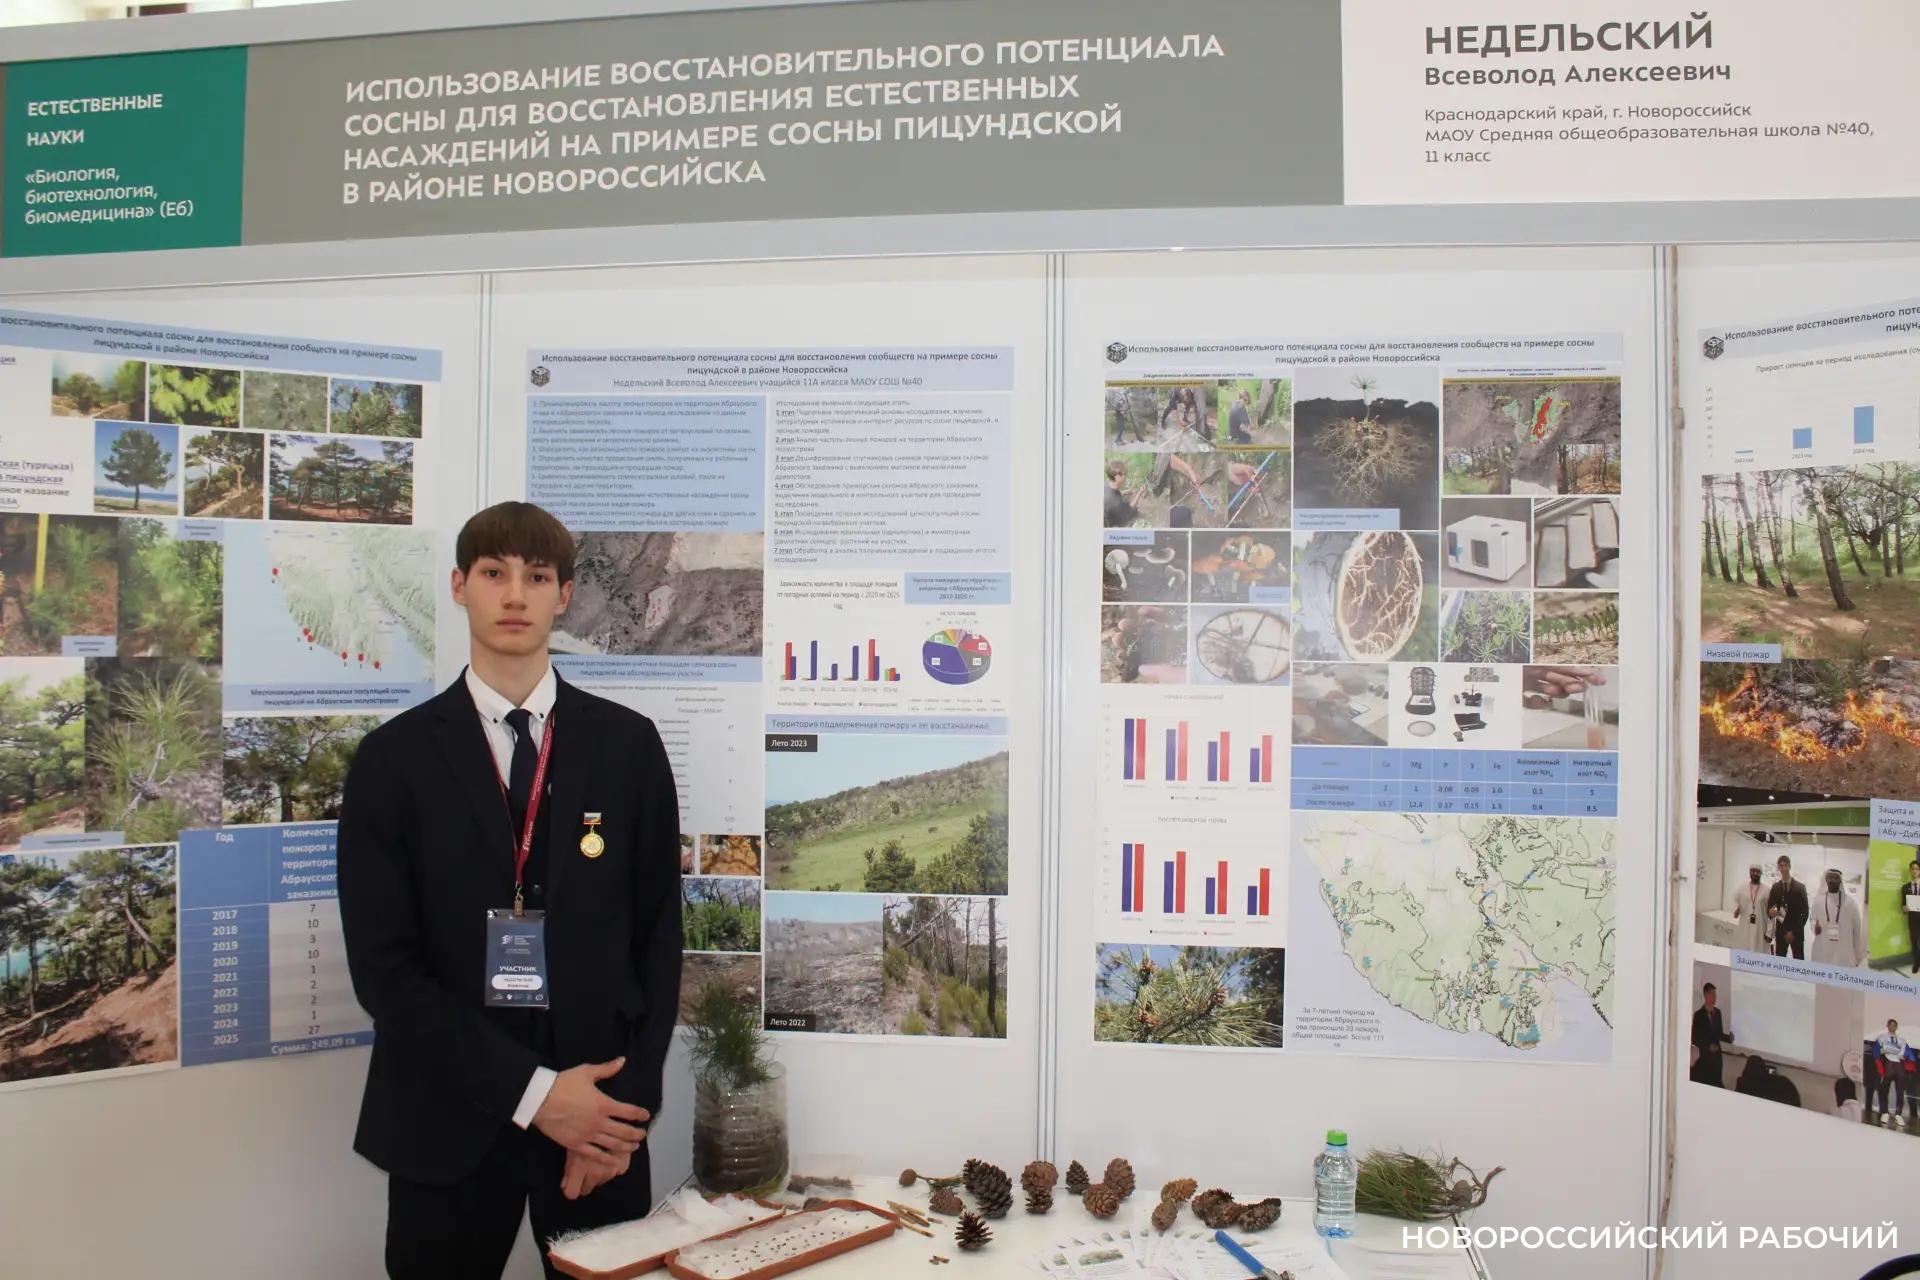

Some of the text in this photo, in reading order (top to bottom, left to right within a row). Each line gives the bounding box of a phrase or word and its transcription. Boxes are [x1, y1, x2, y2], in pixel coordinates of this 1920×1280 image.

[1425, 11, 1713, 58] НЕДЕЛЬСКИЙ
[346, 34, 1224, 103] ИСПОЛЬЗОВАНИЕ ВОССТАНОВИТЕЛЬНОГО ПОТЕНЦИАЛА
[1425, 62, 1731, 87] Всеволод Алексеевич
[27, 93, 163, 117] ЕСТЕСТВЕННЫЕ
[345, 74, 1079, 137] СОСНЫ ДЛЯ ВОССТАНОВЛЕНИЯ ЕСТЕСТВЕННЫХ
[1425, 102, 1752, 122] Краснодарский край, г. Новороссийск
[27, 129, 84, 147] НАУКИ
[344, 103, 1122, 170] НАСАЖДЕНИЙ НА ПРИМЕРЕ СОСНЫ ПИЦУНДСКОЙ
[1425, 122, 1874, 143] МАОУ Средняя общеобразовательная школа №40,
[1425, 150, 1492, 163] 11 класс
[25, 167, 120, 184] «Биология,
[344, 156, 766, 205] В РАЙОНЕ НОВОРОССИЙСКА
[25, 185, 158, 204] биотехнология,
[25, 205, 154, 225] биомедицина»
[1725, 305, 1920, 342] Использование восстановительного поте
[1886, 321, 1920, 333] пицун
[93, 338, 152, 351] пицундской
[163, 344, 198, 355] районе
[200, 347, 269, 361] Новороссийска
[106, 326, 163, 339] потенциала
[165, 332, 195, 342] сосны
[196, 334, 214, 344] для
[216, 336, 289, 350] восстановления
[291, 343, 337, 355] сообществ
[338, 348, 350, 356] на
[351, 349, 389, 360] примере
[391, 353, 417, 362] сосны
[1128, 344, 1193, 353] Использование
[1196, 343, 1284, 353] восстановительного
[1286, 342, 1337, 352] потенциала
[1340, 342, 1366, 350] сосны
[1369, 342, 1385, 351] для
[1387, 341, 1458, 350] восстановления
[1460, 340, 1509, 350] сообществ
[1524, 339, 1564, 349] примере
[1566, 339, 1594, 347] сосны
[542, 354, 607, 362] Использование
[609, 354, 695, 363] восстановительного
[698, 354, 748, 363] потенциала
[750, 354, 777, 362] сосны
[779, 354, 795, 362] для
[797, 353, 866, 361] восстановления
[868, 353, 914, 362] сообществ
[930, 352, 969, 361] примере
[971, 352, 998, 360] сосны
[1275, 355, 1328, 364] пицундской
[1338, 355, 1370, 364] районе
[1372, 354, 1440, 363] Новороссийска
[687, 365, 739, 376] пицундской
[748, 366, 780, 376] районе
[782, 365, 848, 374] Новороссийска
[613, 378, 664, 387] Недельский
[666, 378, 706, 388] Всеволод
[708, 378, 757, 387] Алексеевич
[758, 378, 800, 388] учащийся
[820, 378, 849, 387] класса
[851, 378, 876, 387] МАОУ
[878, 377, 900, 386] СОШ
[1706, 649, 1769, 660] Низовой пожар
[771, 739, 807, 747] Лето 2023
[1878, 817, 1920, 829] награжден
[216, 832, 234, 843] Год
[212, 910, 238, 921] 2017
[212, 925, 238, 936] 2018
[212, 941, 238, 952] 2019
[212, 956, 238, 968] 2020
[212, 972, 238, 983] 2021
[1736, 955, 1765, 968] Защита
[1773, 963, 1826, 979] награждение
[1834, 972, 1875, 988] Тайланде
[1876, 979, 1917, 995] (Бангкок)
[212, 988, 238, 998] 2022
[212, 1003, 238, 1014] 2023
[212, 1018, 238, 1030] 2024
[770, 1018, 787, 1026] Лето
[212, 1034, 238, 1045] 2025
